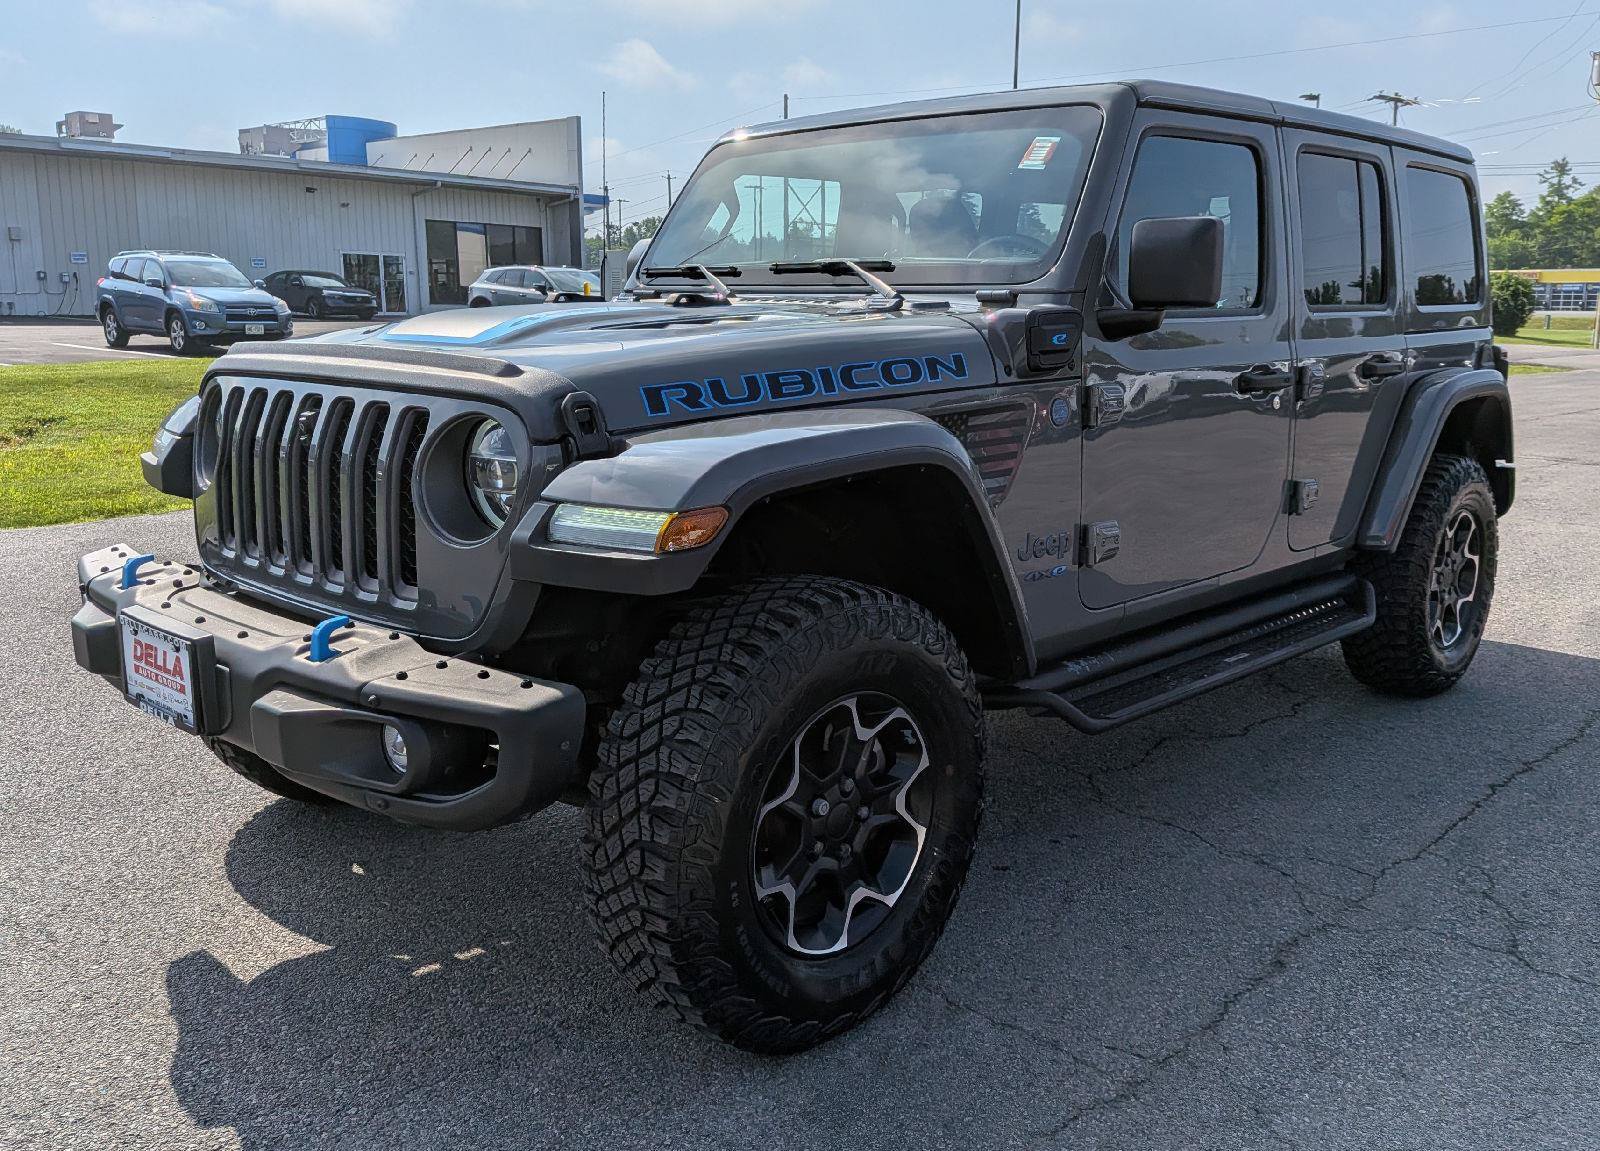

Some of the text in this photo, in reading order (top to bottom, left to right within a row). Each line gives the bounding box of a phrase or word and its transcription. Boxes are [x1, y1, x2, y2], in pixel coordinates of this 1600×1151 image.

[640, 353, 968, 416] RUBICON
[1017, 531, 1068, 561] Jeep
[133, 638, 185, 681] DELLA
[139, 668, 181, 692] AUTO GROUP
